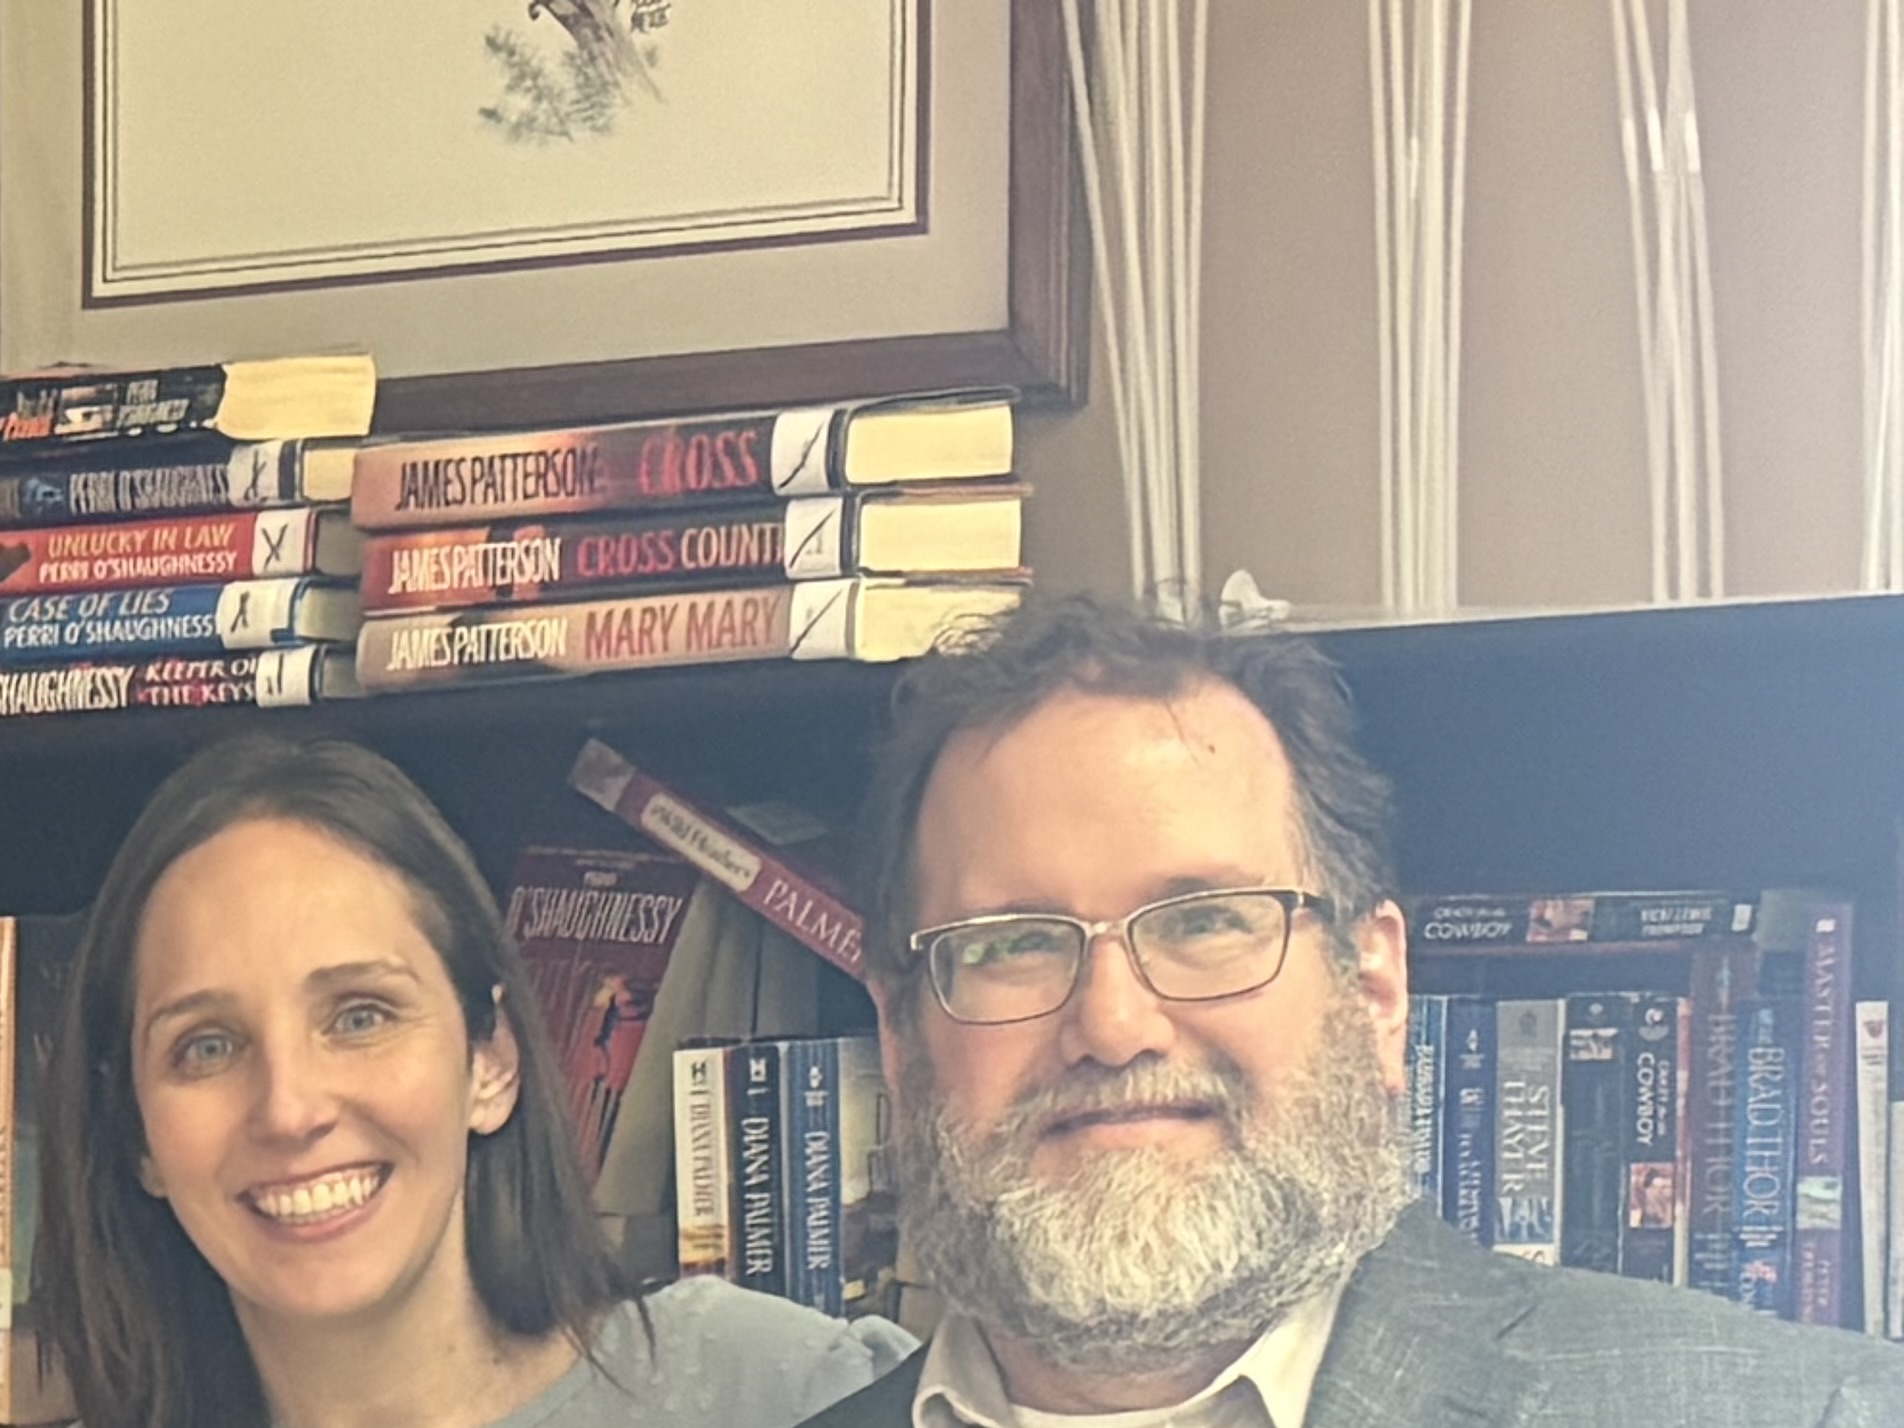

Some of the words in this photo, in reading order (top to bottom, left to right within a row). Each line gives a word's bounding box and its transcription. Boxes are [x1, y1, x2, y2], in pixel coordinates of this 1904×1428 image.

[395, 453, 468, 511] JAMES
[469, 444, 604, 507] PATTERSON
[640, 428, 760, 498] CROSS
[38, 561, 89, 585] PERRI
[93, 550, 236, 581] O'SHAUGHNESSY
[47, 527, 148, 558] UNLUCKY
[153, 526, 180, 552] IN
[184, 521, 235, 550] LAW
[388, 546, 450, 596] JAMES
[452, 537, 561, 591] PATTERSON
[576, 530, 676, 578] CROSS
[4, 623, 60, 649] PERRI
[9, 595, 71, 625] CASE
[78, 591, 113, 619] OF
[118, 588, 170, 617] LIES
[387, 623, 450, 671] JAMES
[452, 617, 567, 664] PATTERSON
[584, 604, 677, 660] MARY
[686, 598, 784, 653] MARY
[148, 685, 198, 708] THE
[202, 683, 256, 707] KEYS
[508, 885, 683, 946] O'SHAUGHNESSY
[1422, 918, 1514, 942] COWBOY
[1814, 943, 1838, 1052] MASTER
[1636, 1051, 1656, 1147] COWBOY
[1744, 1046, 1786, 1134] BRAD
[1807, 1080, 1830, 1165] SOULS
[740, 1116, 773, 1187] DIANA
[804, 1130, 831, 1192] DIANA
[1501, 1081, 1525, 1194] THAYER
[1530, 1083, 1551, 1181] STEVE
[694, 1155, 717, 1217] PALMER
[1740, 1135, 1787, 1218] THOR
[743, 1192, 776, 1276] PALMER
[805, 1197, 834, 1270] PALMER
